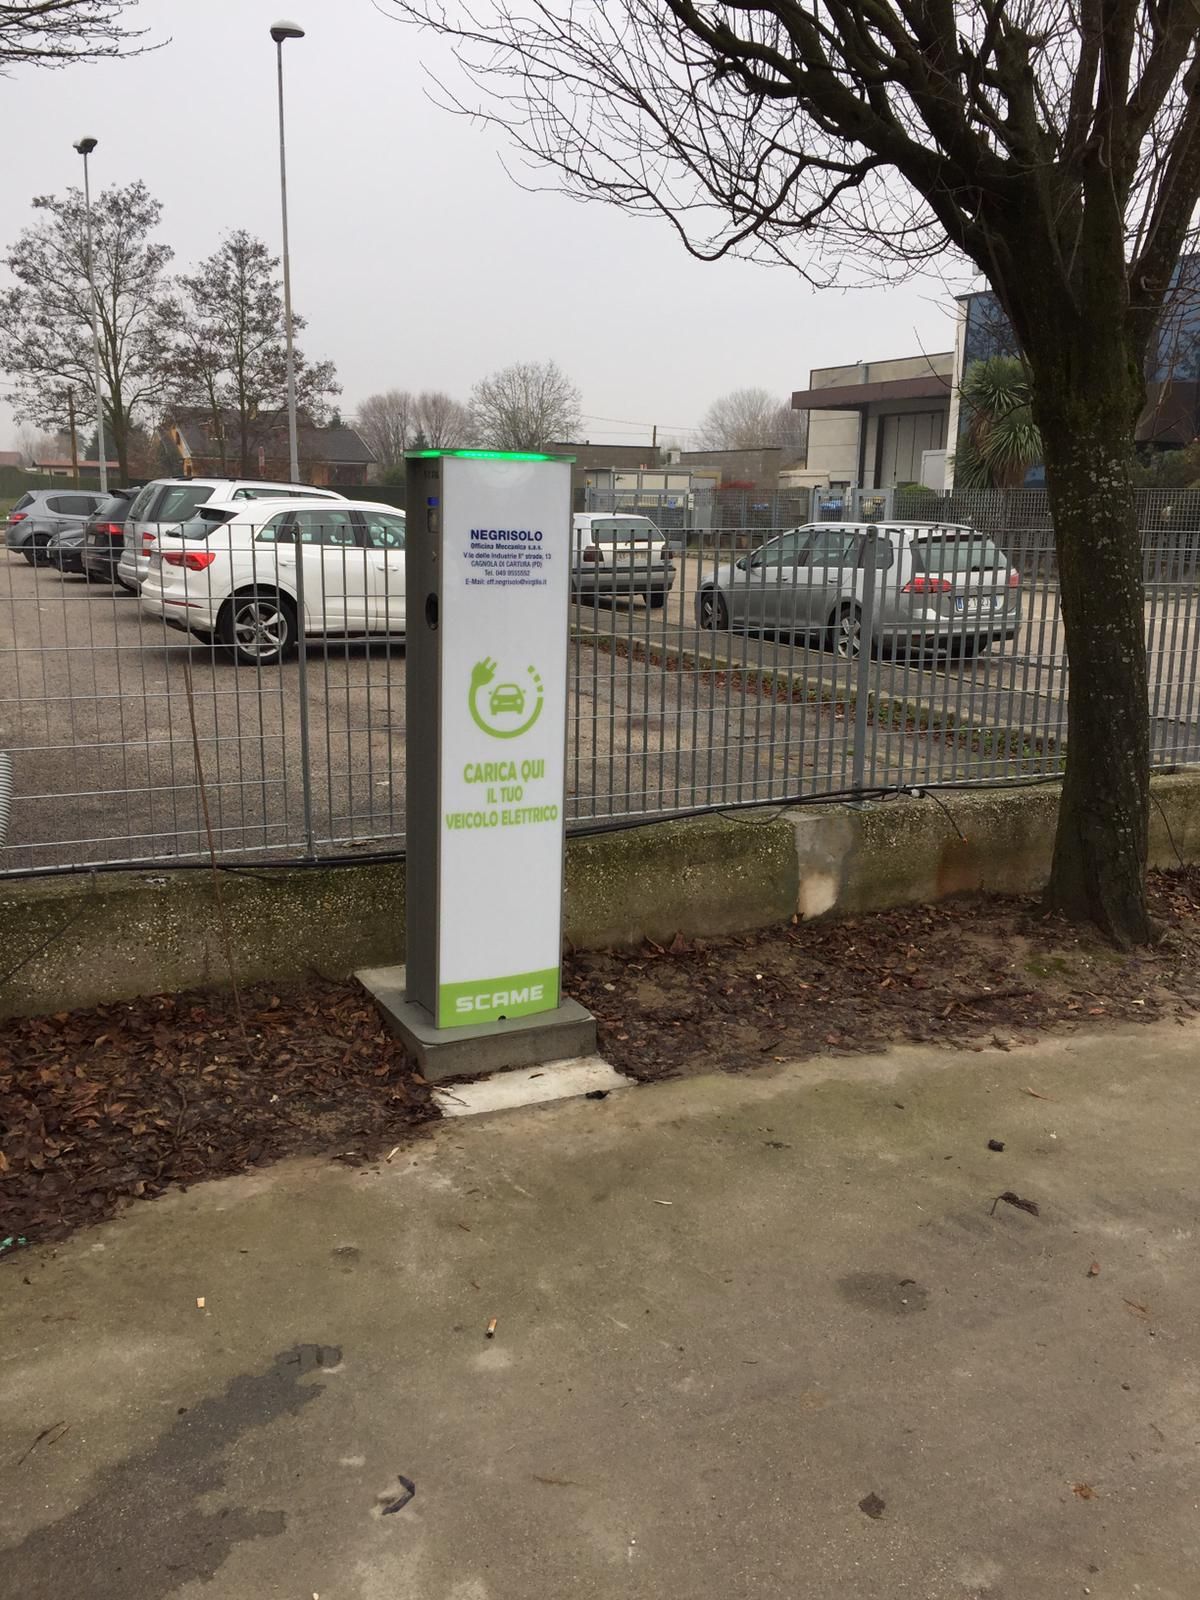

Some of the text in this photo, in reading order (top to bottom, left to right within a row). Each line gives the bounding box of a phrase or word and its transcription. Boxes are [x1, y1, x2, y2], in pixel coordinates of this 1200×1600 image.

[470, 529, 543, 542] NEGRISOLO
[470, 542, 494, 550] Officina
[491, 552, 517, 560] Industrie
[470, 560, 498, 568] CAGNOLA
[505, 560, 531, 568] CARTURA
[532, 561, 543, 569] (PD)
[463, 759, 545, 784] CARICA QUI
[487, 785, 524, 804] IL TUO
[446, 804, 558, 830] VEICOLO ELETTRICO
[455, 984, 544, 1013] SCAME
